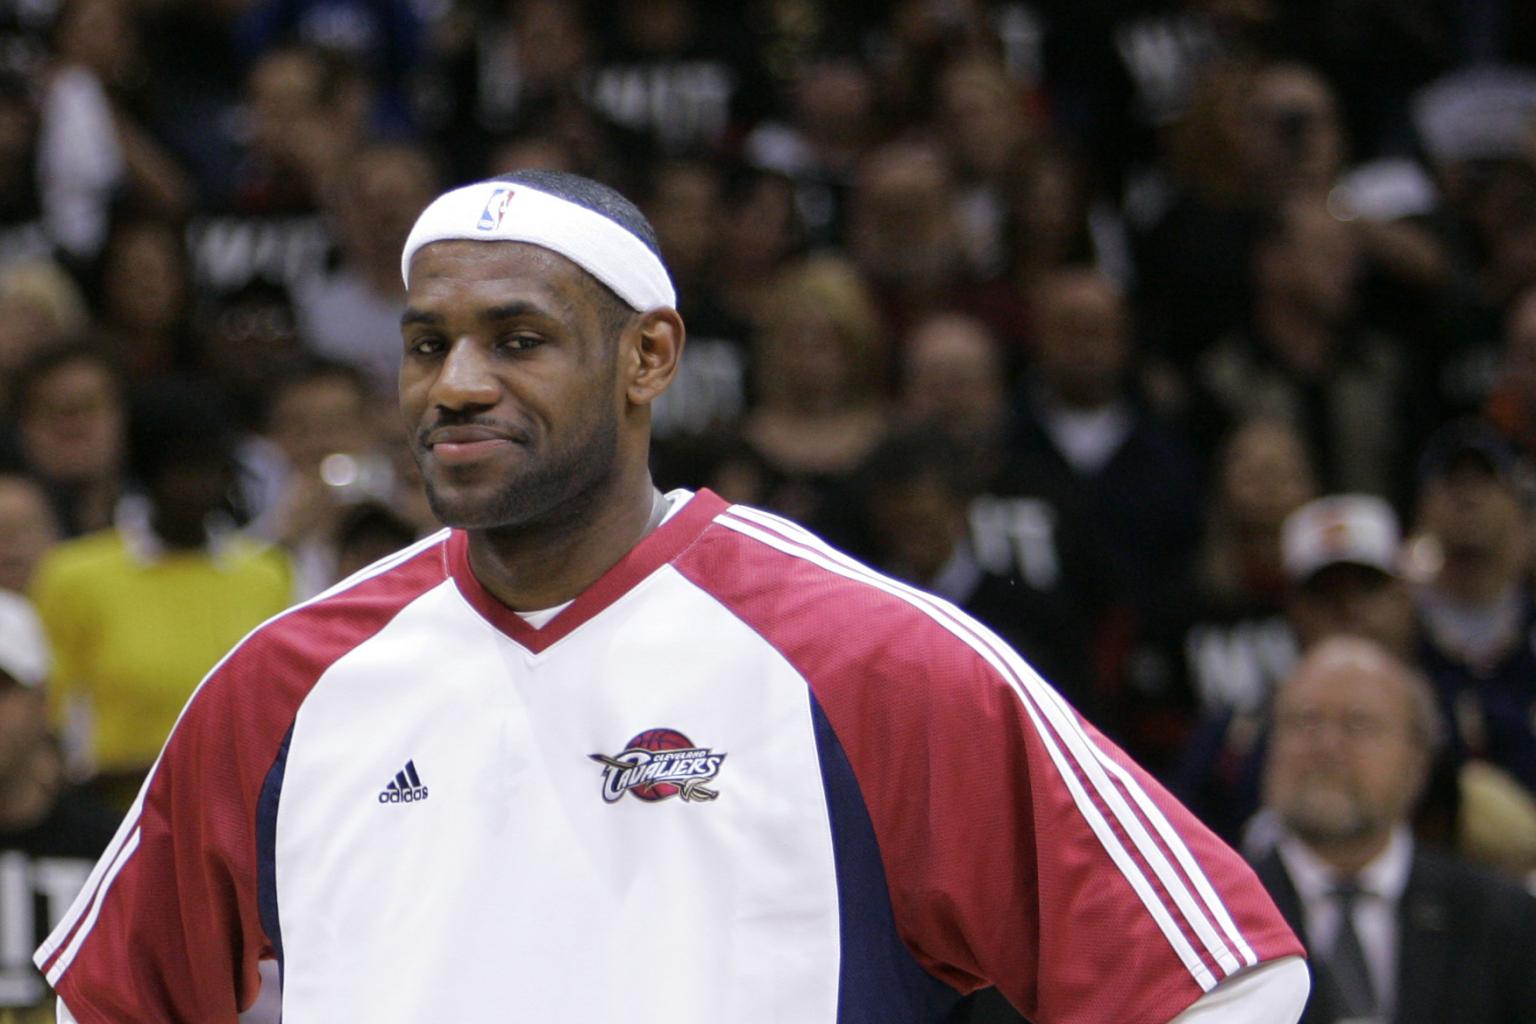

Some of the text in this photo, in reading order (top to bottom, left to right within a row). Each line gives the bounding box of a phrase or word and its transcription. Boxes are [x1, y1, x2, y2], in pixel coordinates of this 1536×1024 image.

[653, 750, 706, 762] CLEVELAND
[603, 751, 721, 803] CAVALIERS
[378, 786, 429, 803] adidas
